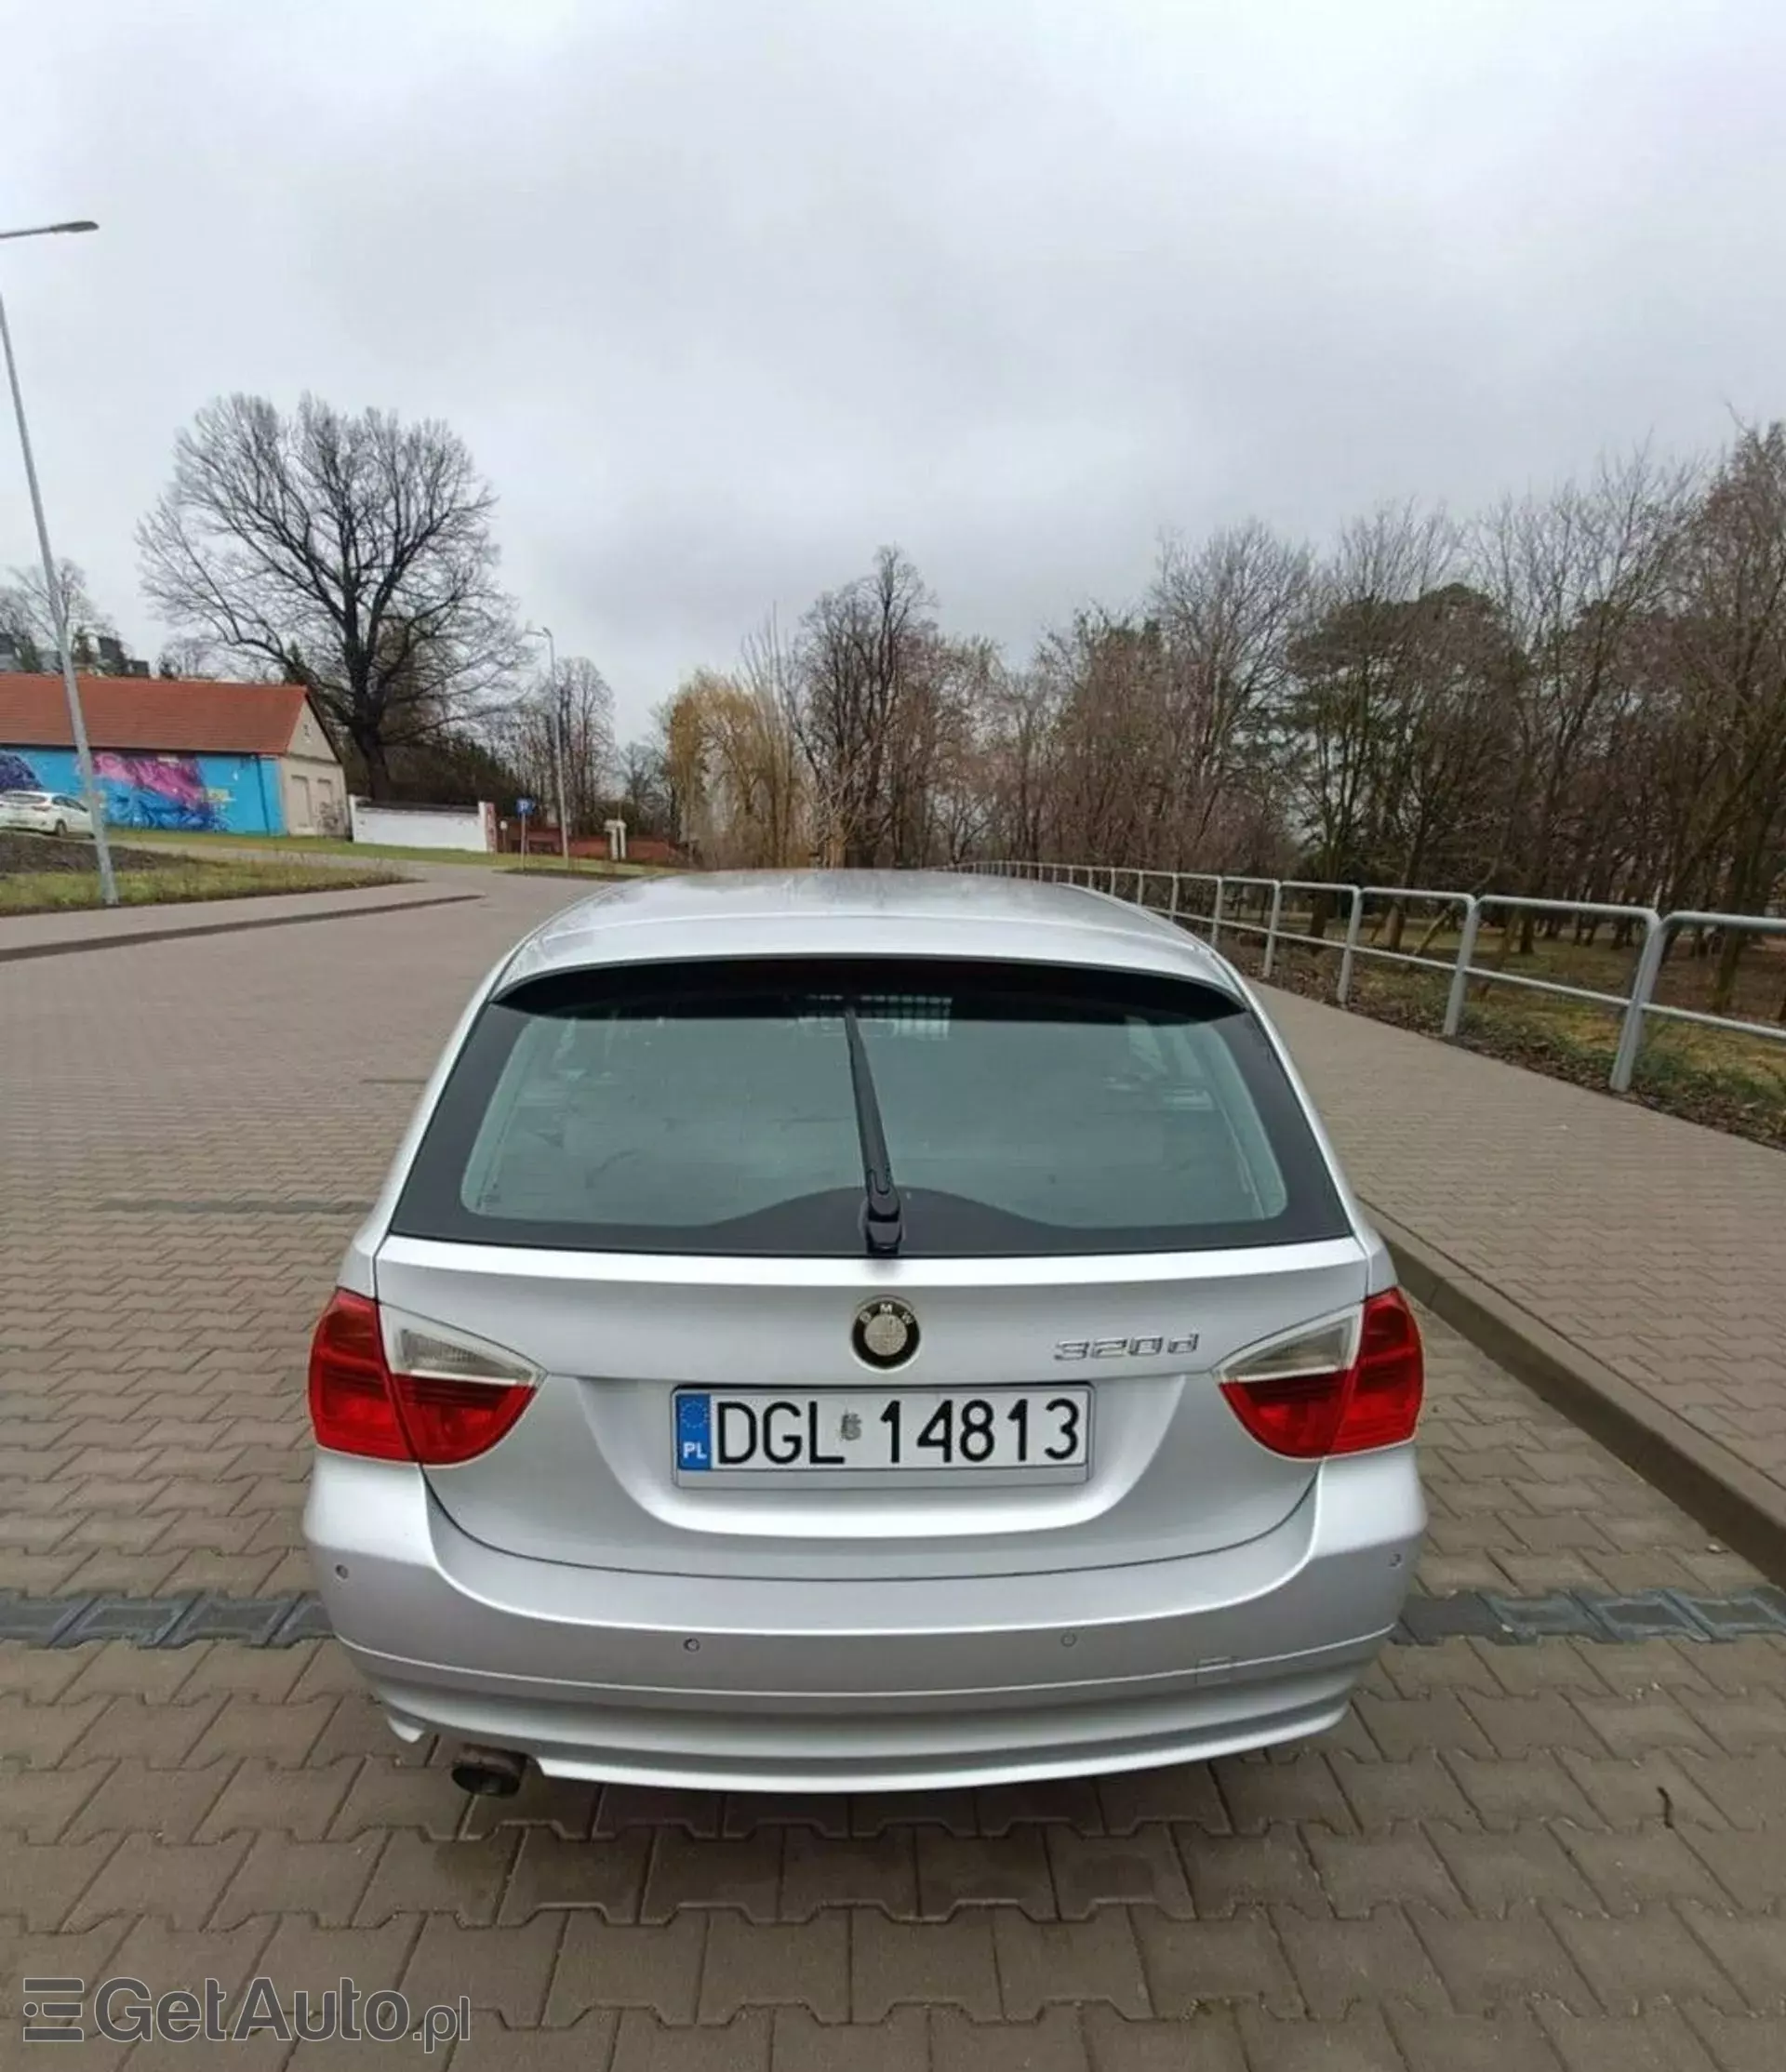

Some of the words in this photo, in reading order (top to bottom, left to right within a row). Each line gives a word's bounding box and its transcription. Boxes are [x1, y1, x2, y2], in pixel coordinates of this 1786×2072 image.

[1054, 1333, 1199, 1361] 320d
[717, 1401, 846, 1464] DGL
[880, 1398, 1079, 1463] 14813
[683, 1441, 707, 1459] PL
